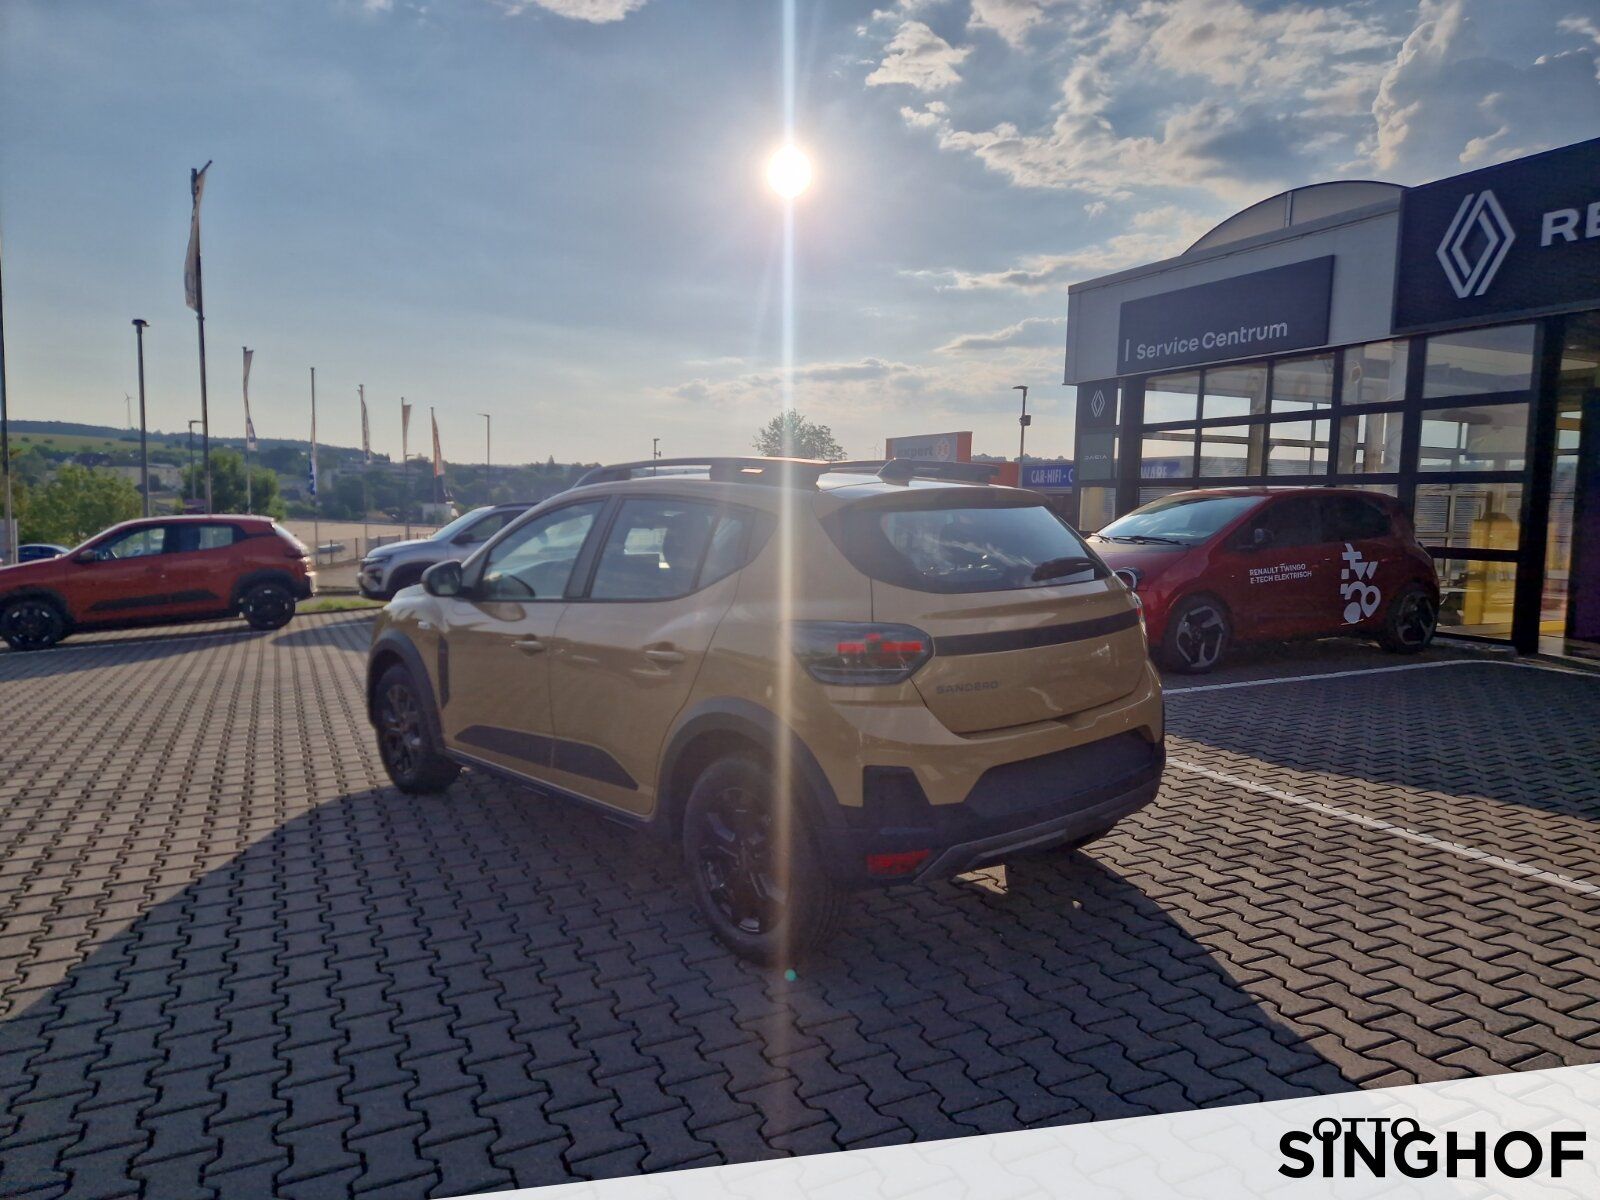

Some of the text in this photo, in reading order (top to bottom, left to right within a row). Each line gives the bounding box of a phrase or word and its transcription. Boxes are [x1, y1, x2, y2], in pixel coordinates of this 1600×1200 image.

[1136, 322, 1288, 360] Service Centrum
[1031, 468, 1061, 483] CAR-HIFI
[1249, 563, 1306, 576] RENAULT TWINGO
[1250, 571, 1312, 584] E-TECH ELEKTRISCH
[936, 681, 999, 694] SANDERO
